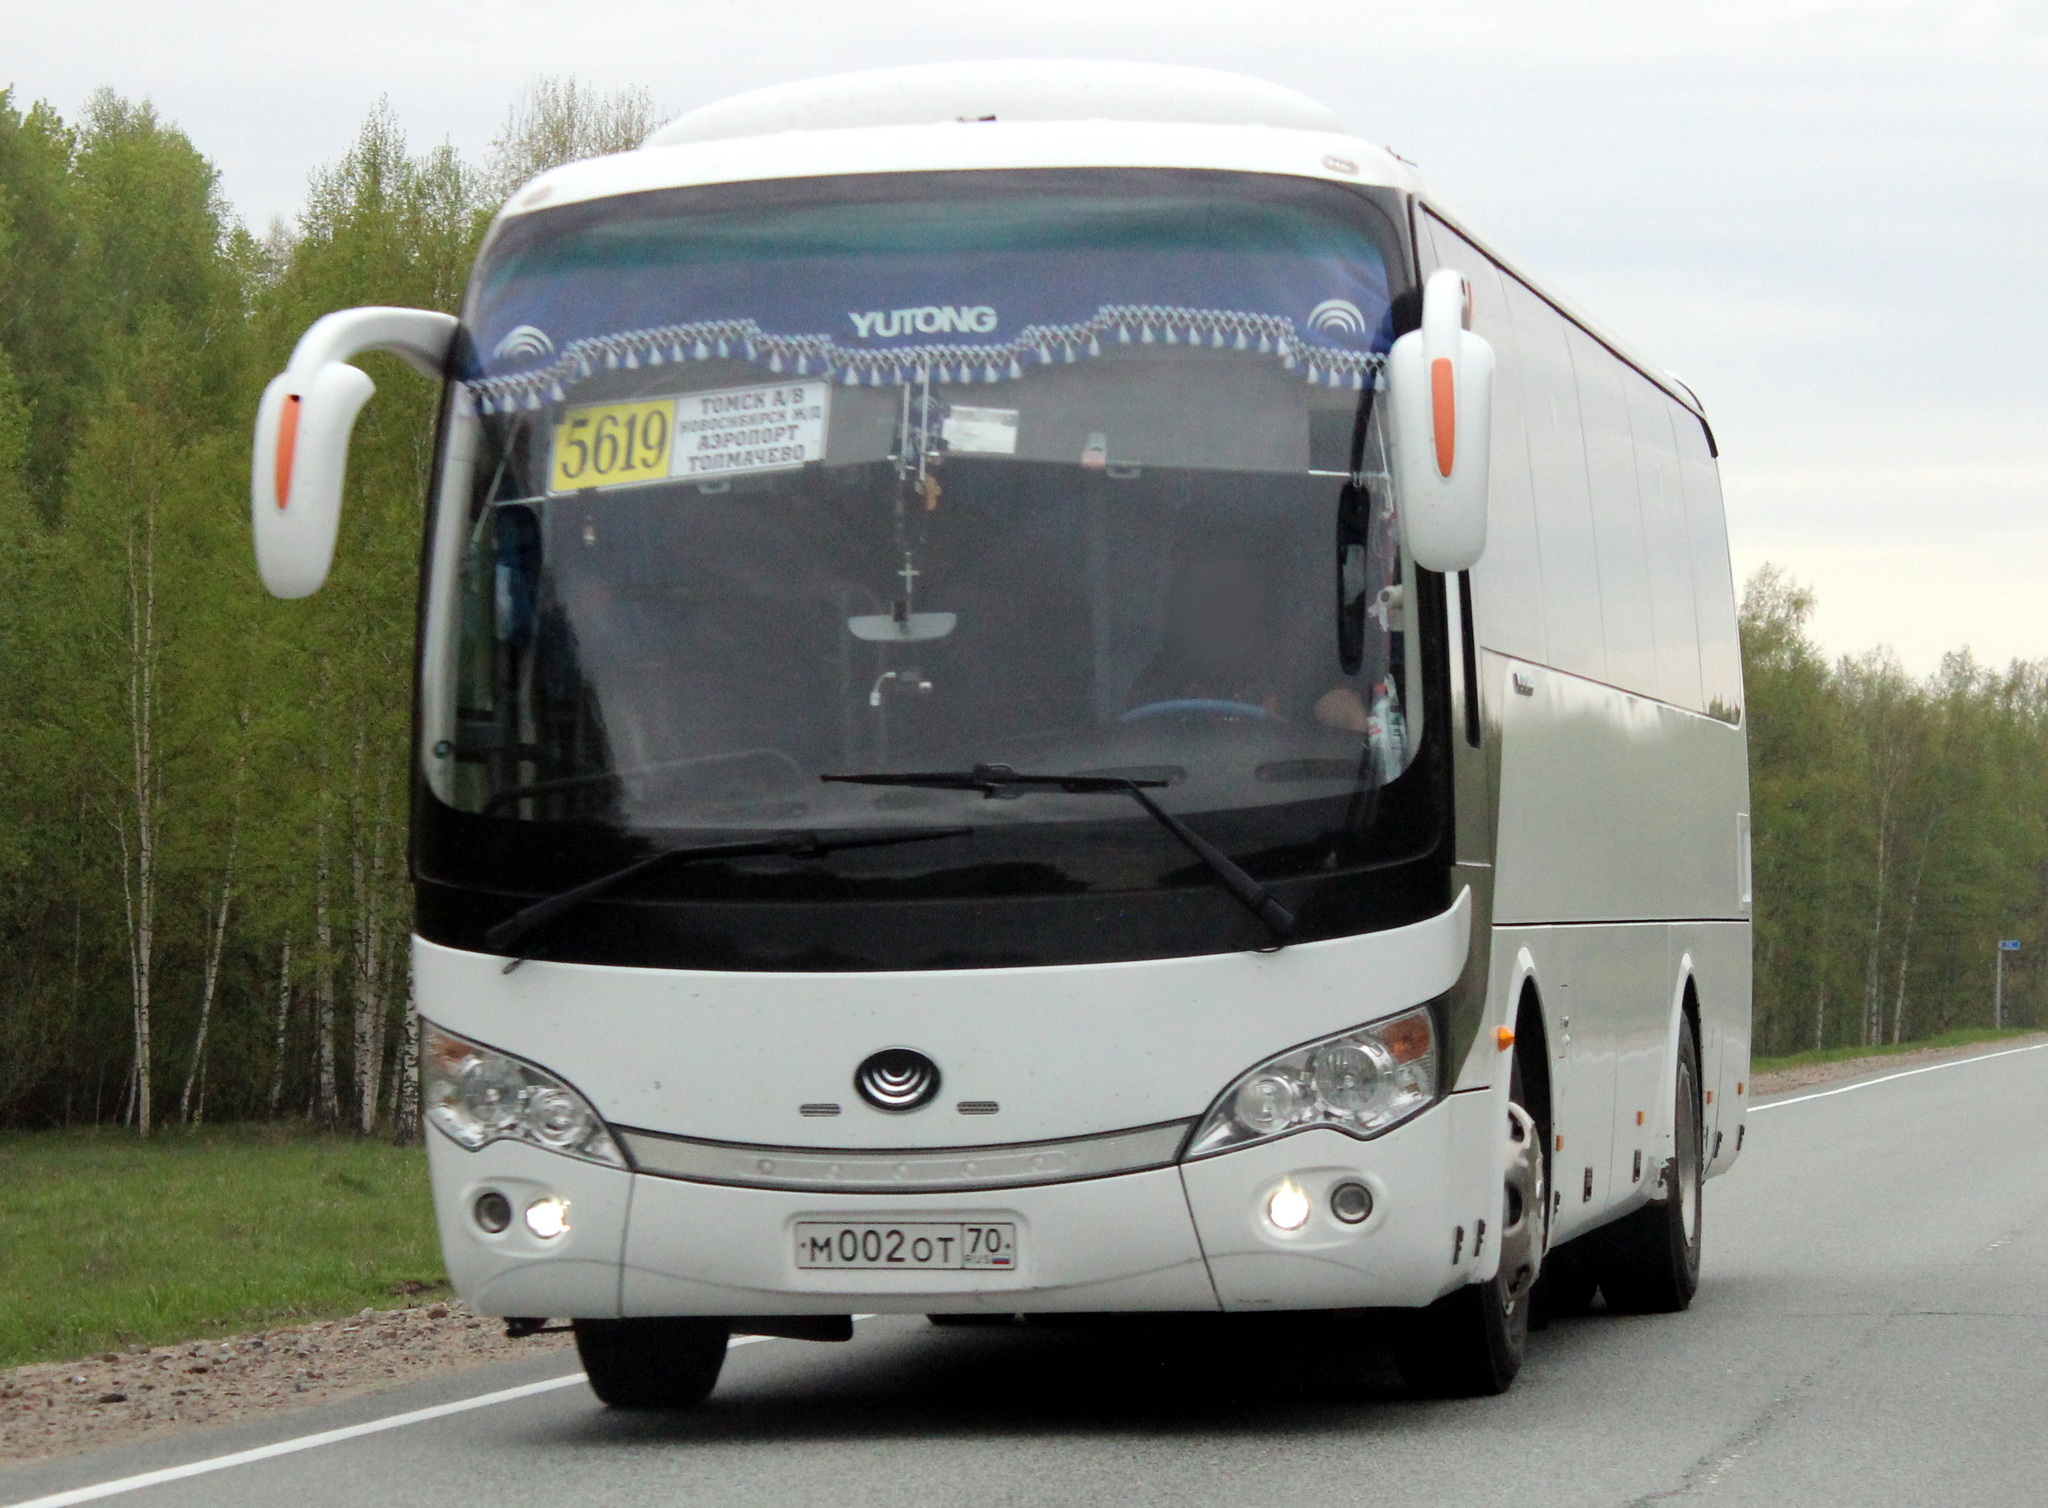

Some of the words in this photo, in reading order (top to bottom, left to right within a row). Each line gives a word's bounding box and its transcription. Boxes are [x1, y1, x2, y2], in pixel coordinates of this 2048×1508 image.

[848, 306, 998, 338] YUTONG
[701, 392, 766, 414] ТОМСК
[680, 410, 786, 433] НОВОСИБИРСК
[561, 409, 668, 479] 5619
[698, 424, 799, 450] АЭРОПОРТ
[688, 444, 806, 472] ТОЛМАЧЕВО
[967, 1228, 1001, 1253] 70
